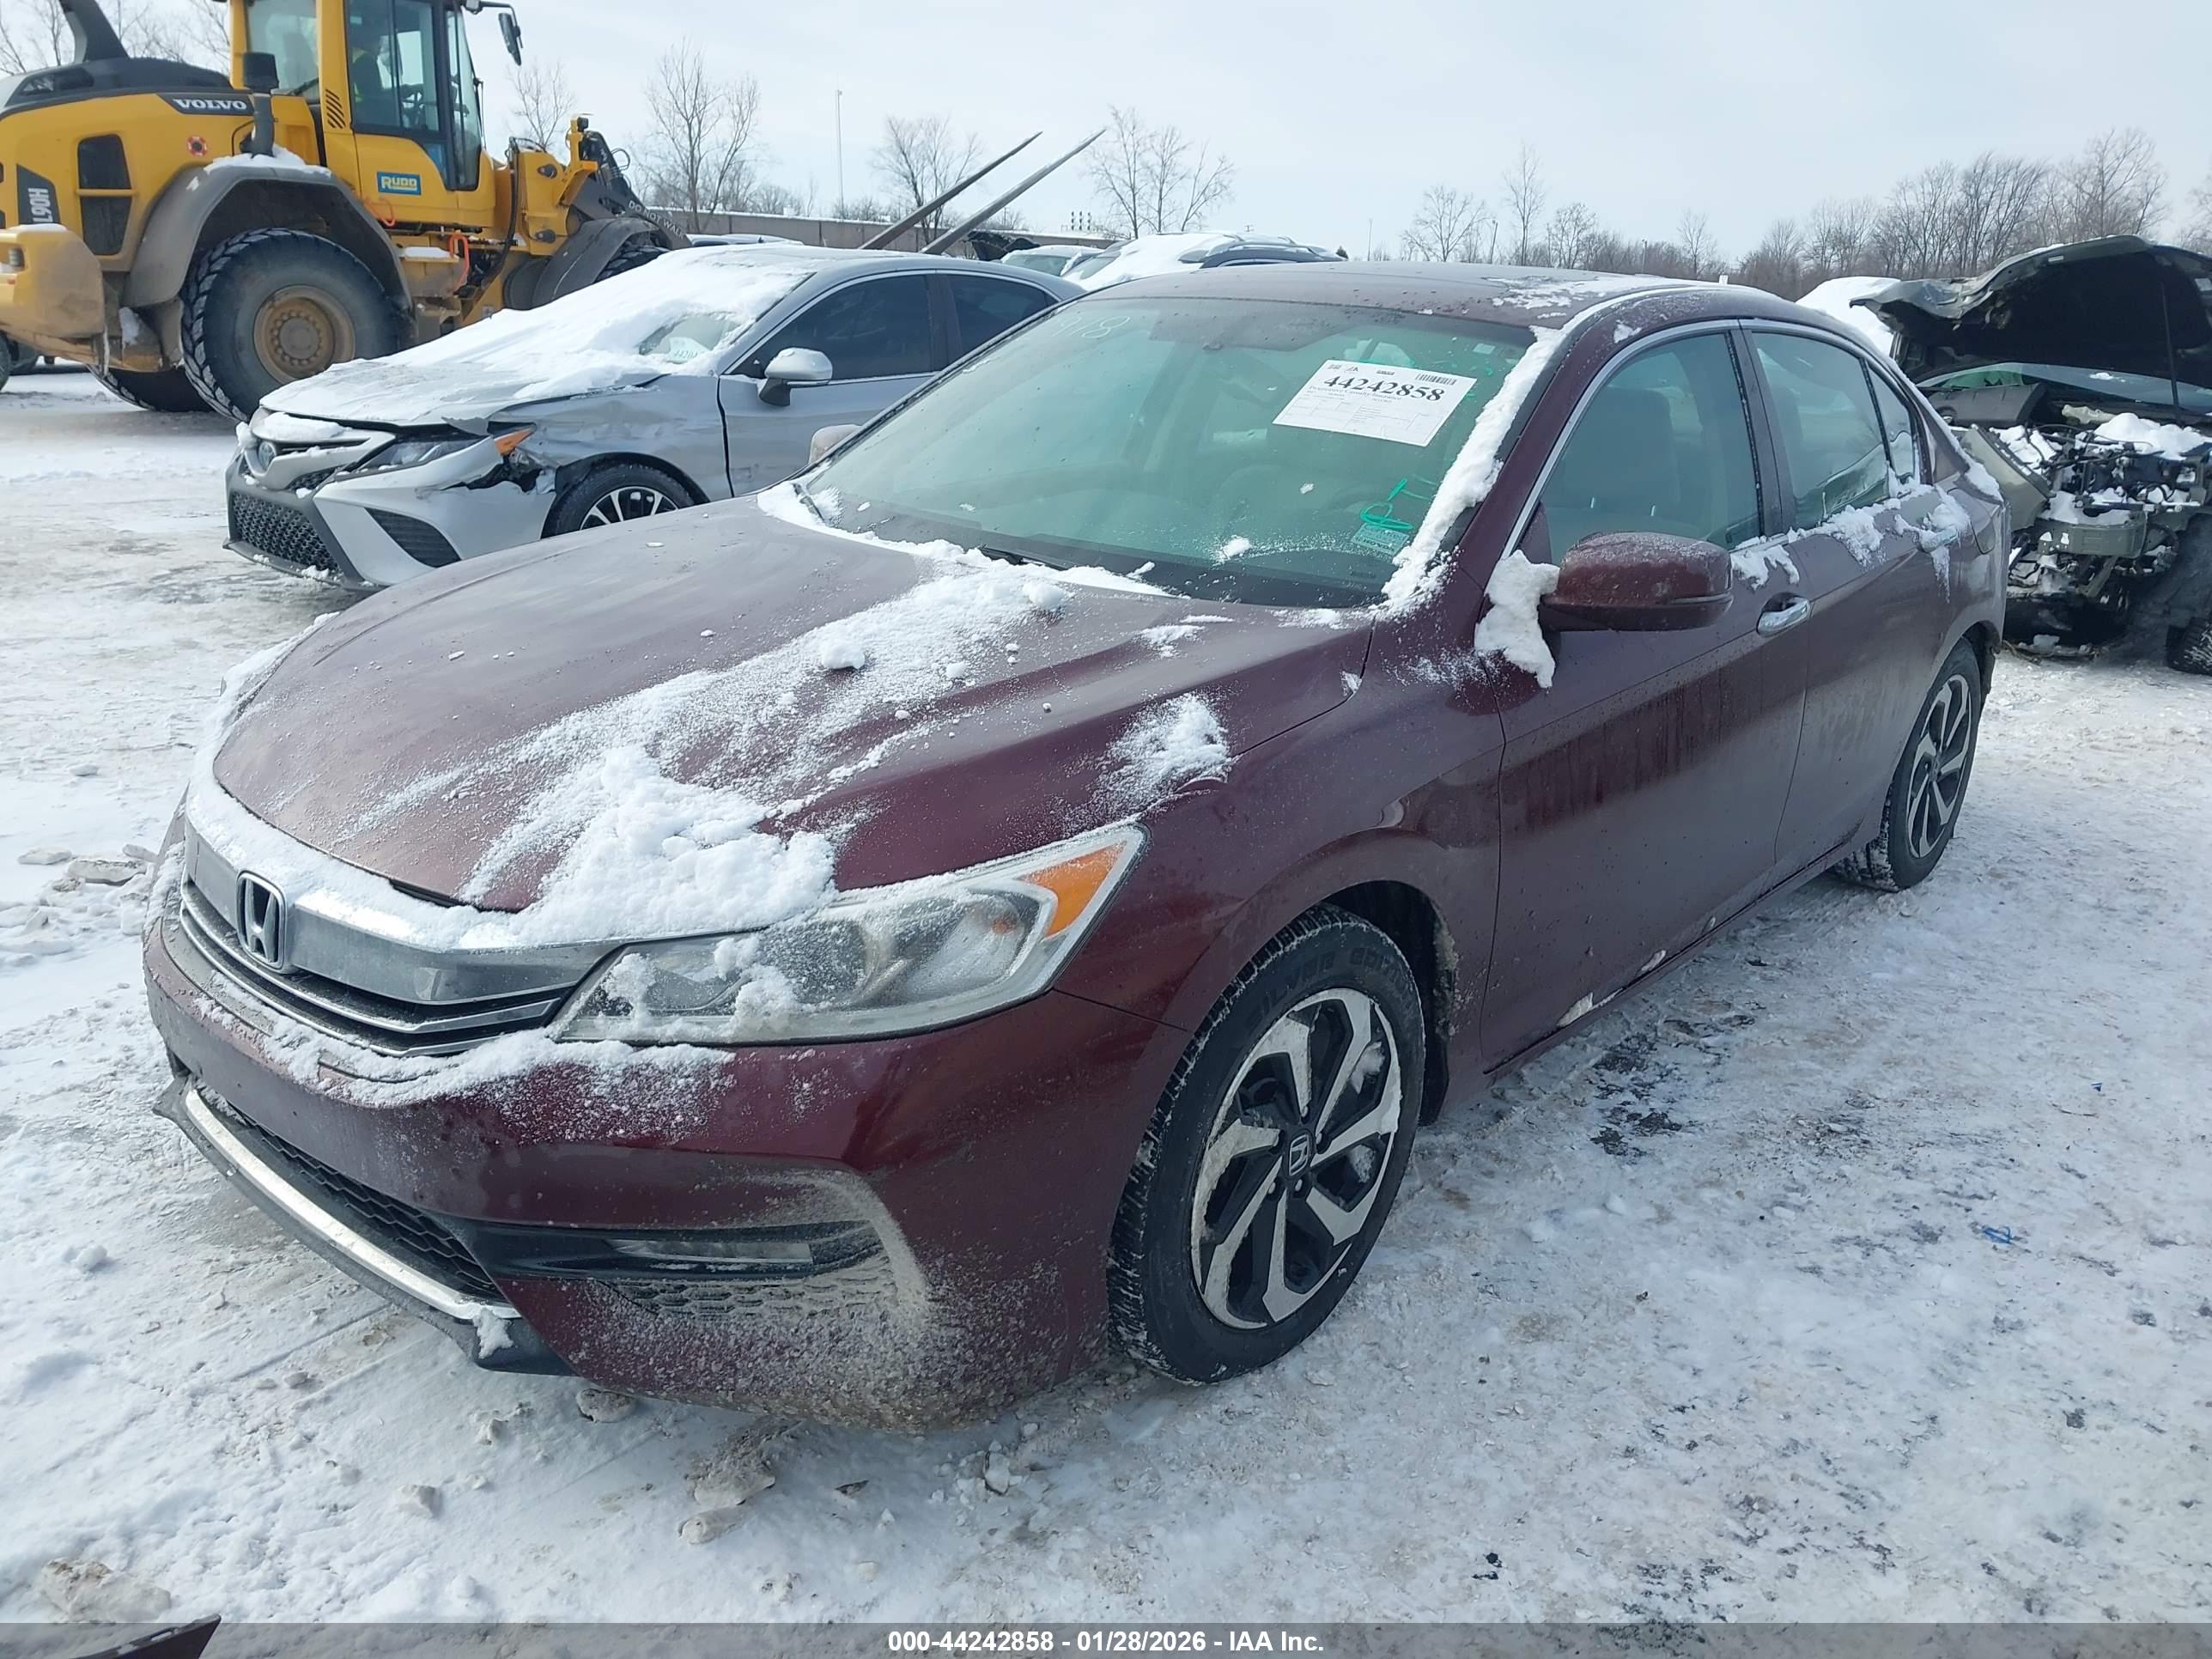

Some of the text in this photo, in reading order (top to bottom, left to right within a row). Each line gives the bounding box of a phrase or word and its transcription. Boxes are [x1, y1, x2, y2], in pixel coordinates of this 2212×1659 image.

[172, 98, 247, 110] VOLVO
[380, 176, 417, 191] RUDD
[27, 187, 53, 222] L90H
[628, 200, 684, 240] DO NOT WALK
[1323, 375, 1445, 402] 44242858
